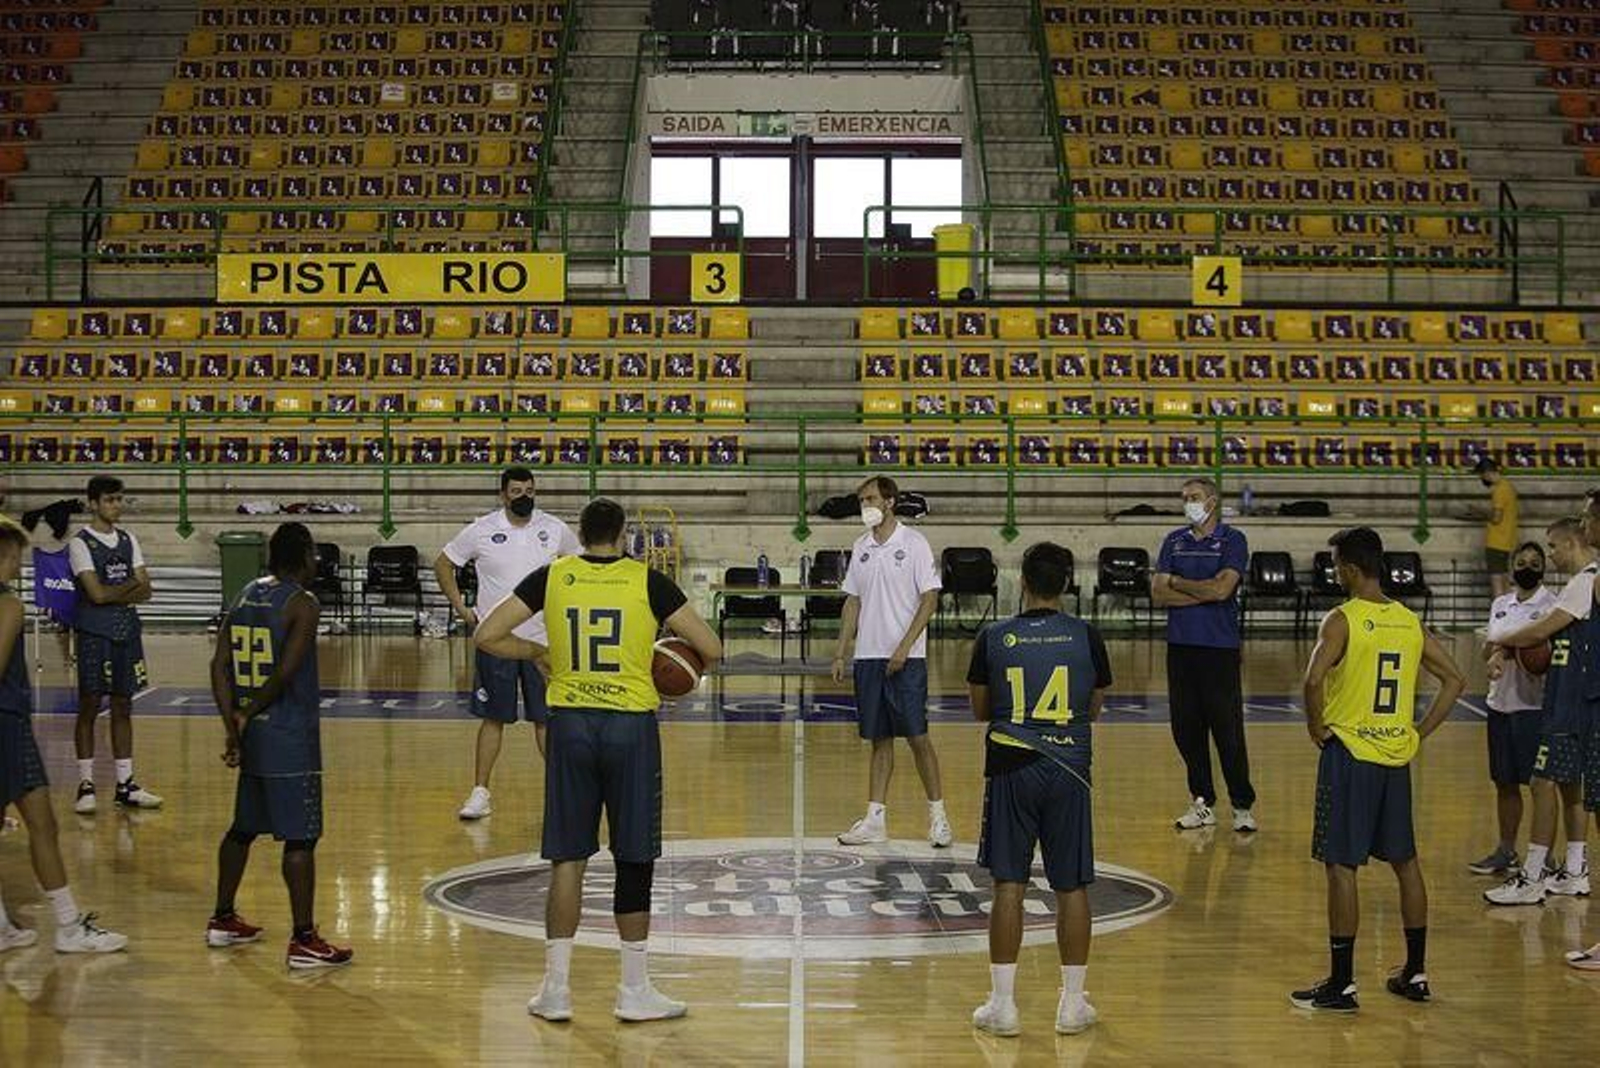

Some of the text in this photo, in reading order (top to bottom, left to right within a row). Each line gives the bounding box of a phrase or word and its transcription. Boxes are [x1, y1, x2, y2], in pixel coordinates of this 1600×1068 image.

[662, 116, 951, 132] SAIDA EMERXENCIA
[250, 260, 528, 294] PISTA RIO
[705, 262, 727, 294] 3
[1205, 265, 1228, 297] 4
[231, 625, 273, 689] 22
[566, 607, 623, 673] 12
[1006, 665, 1075, 726] 14
[1373, 652, 1401, 715] 6
